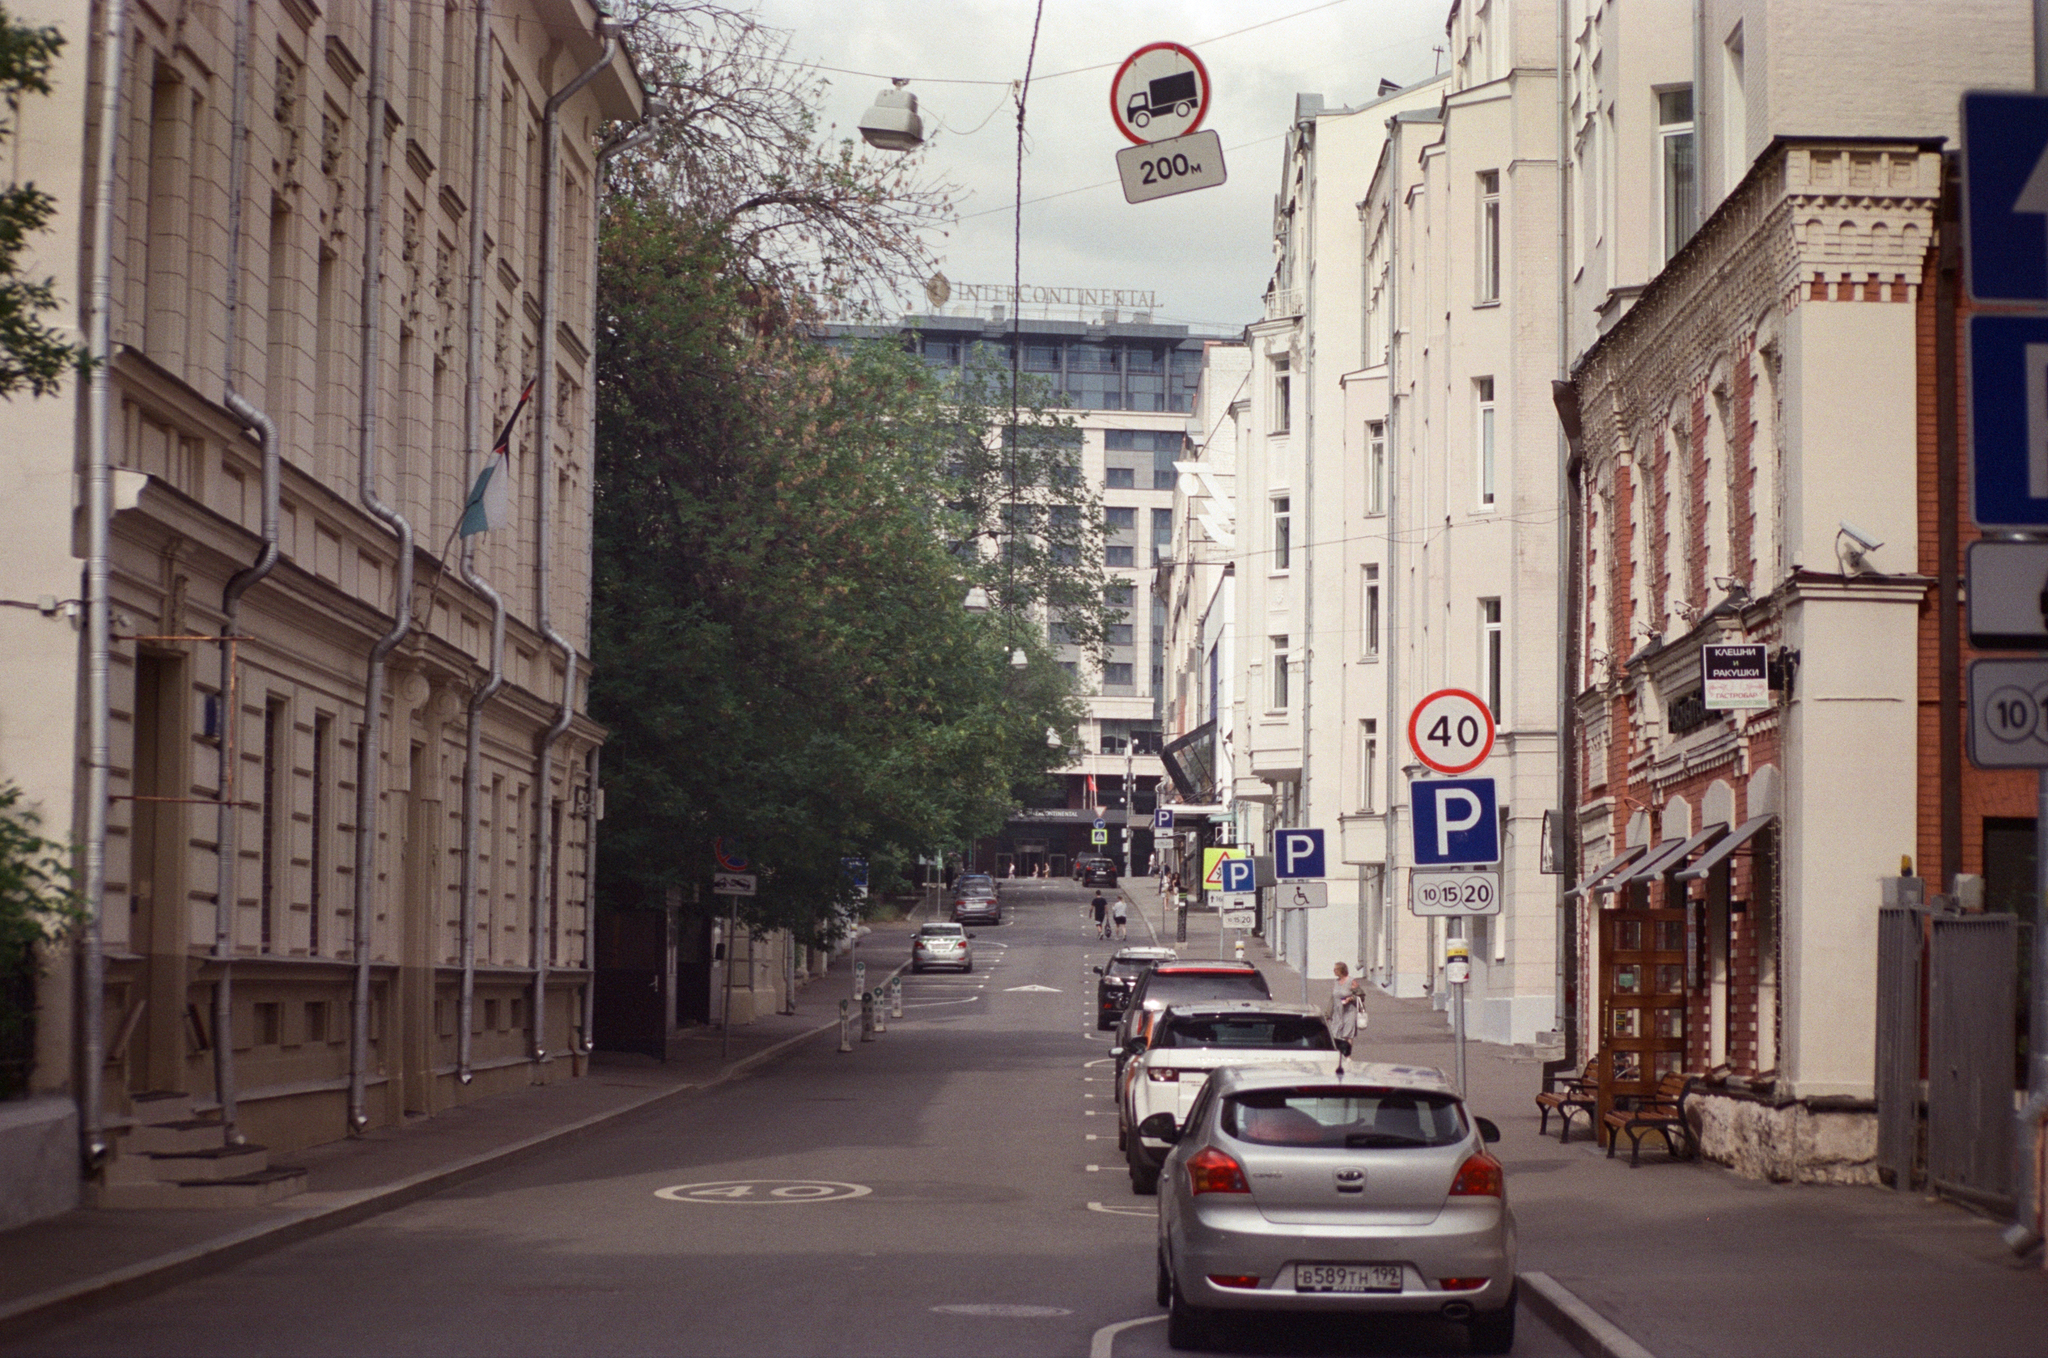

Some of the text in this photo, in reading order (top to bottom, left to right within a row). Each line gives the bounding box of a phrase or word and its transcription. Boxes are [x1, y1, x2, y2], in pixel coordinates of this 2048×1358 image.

[1715, 648, 1756, 657] КЛЕШНИ
[1713, 668, 1760, 678] РАКУШКИ
[1427, 715, 1479, 748] 40
[1158, 811, 1170, 826] P
[1435, 788, 1482, 856] P
[1286, 834, 1315, 874] P
[1230, 863, 1249, 890] P
[1423, 885, 1490, 903] 10 15 20
[1241, 916, 1251, 924] 20
[689, 1185, 835, 1198] 40
